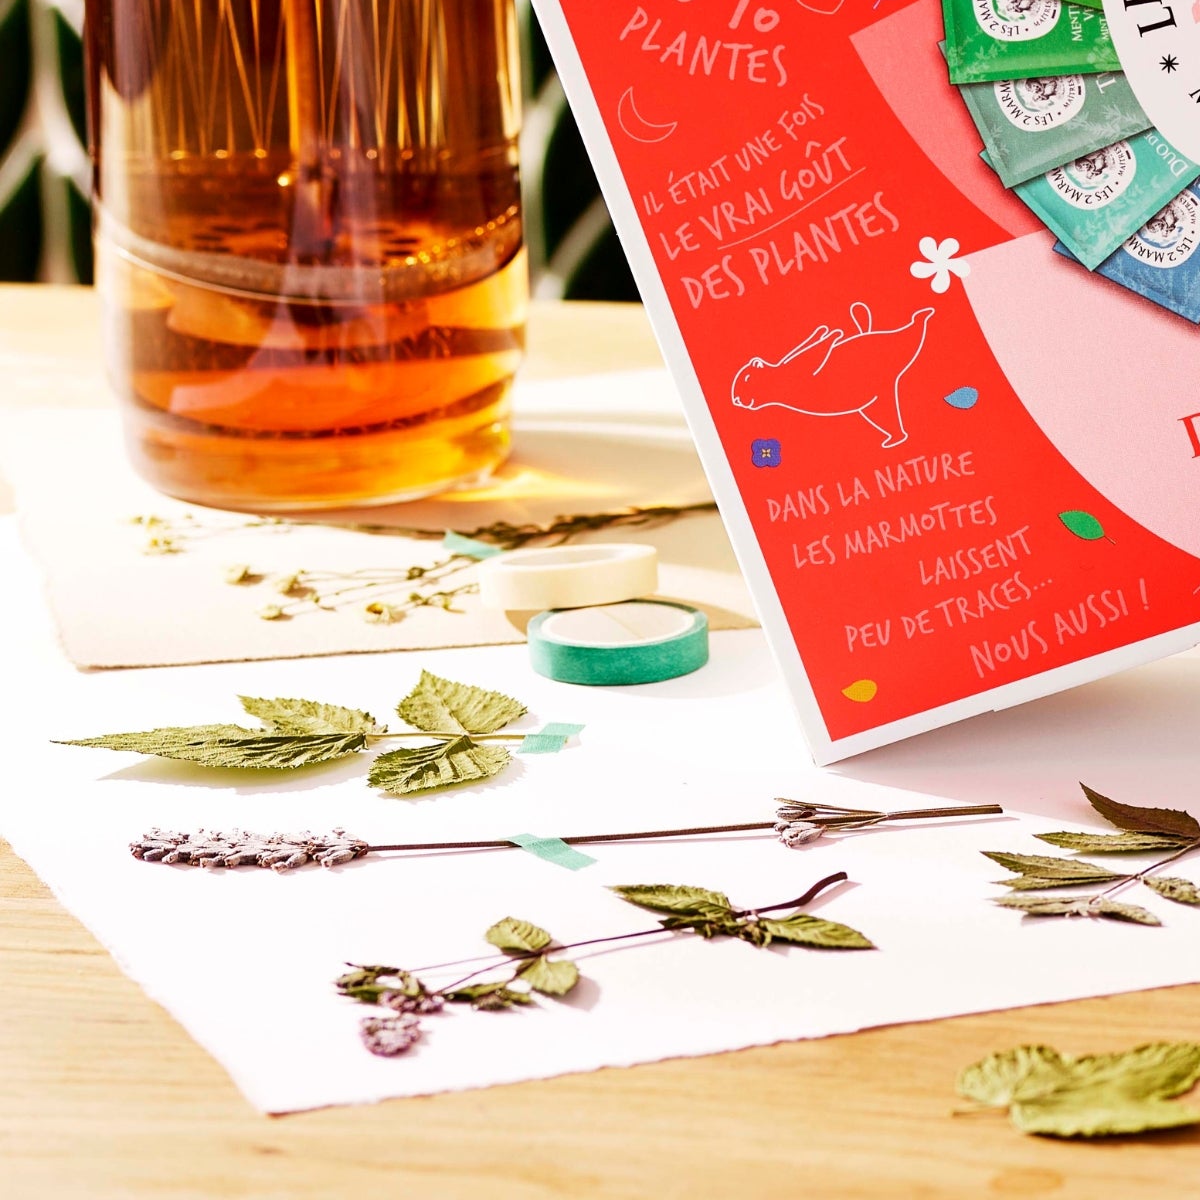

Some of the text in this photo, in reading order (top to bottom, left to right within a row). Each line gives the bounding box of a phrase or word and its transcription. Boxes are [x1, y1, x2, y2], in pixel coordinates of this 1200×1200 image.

[618, 6, 789, 88] PLANTES
[642, 93, 825, 216] IL ÉTAIT UNE FOIS
[1156, 141, 1190, 179] DUO
[659, 136, 853, 261] LE VRAI GOÛT
[680, 190, 901, 310] DES PLANTES
[766, 450, 977, 524] DANS LA NATURE
[792, 495, 999, 569] LES MARMOTTES
[918, 525, 1034, 587] LAISSENT
[844, 618, 892, 654] PEU
[900, 609, 935, 640] DE
[968, 620, 1050, 679] NOUS
[1054, 588, 1129, 646] AUSSI
